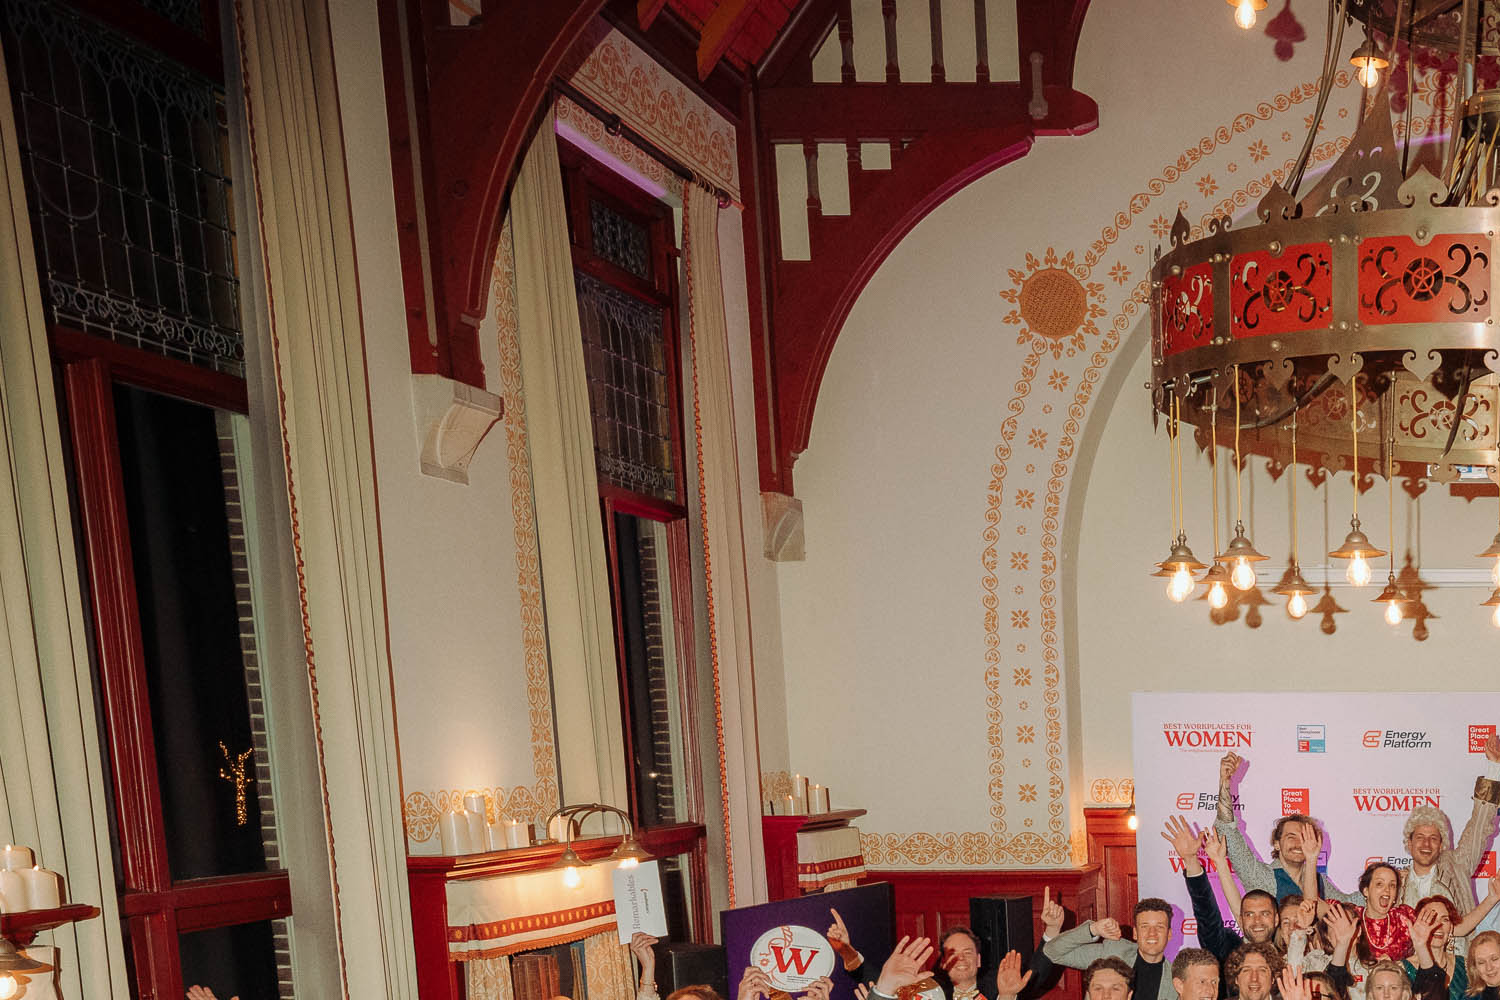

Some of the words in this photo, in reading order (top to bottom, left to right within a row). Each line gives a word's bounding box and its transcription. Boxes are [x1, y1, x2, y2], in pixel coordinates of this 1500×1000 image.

[1163, 730, 1252, 747] WOMEN
[1385, 730, 1426, 740] Energy
[1383, 739, 1432, 748] Platform
[1199, 792, 1240, 803] Eney
[1387, 856, 1412, 865] Ener
[624, 873, 641, 930] Remarkables
[771, 945, 819, 975] W
